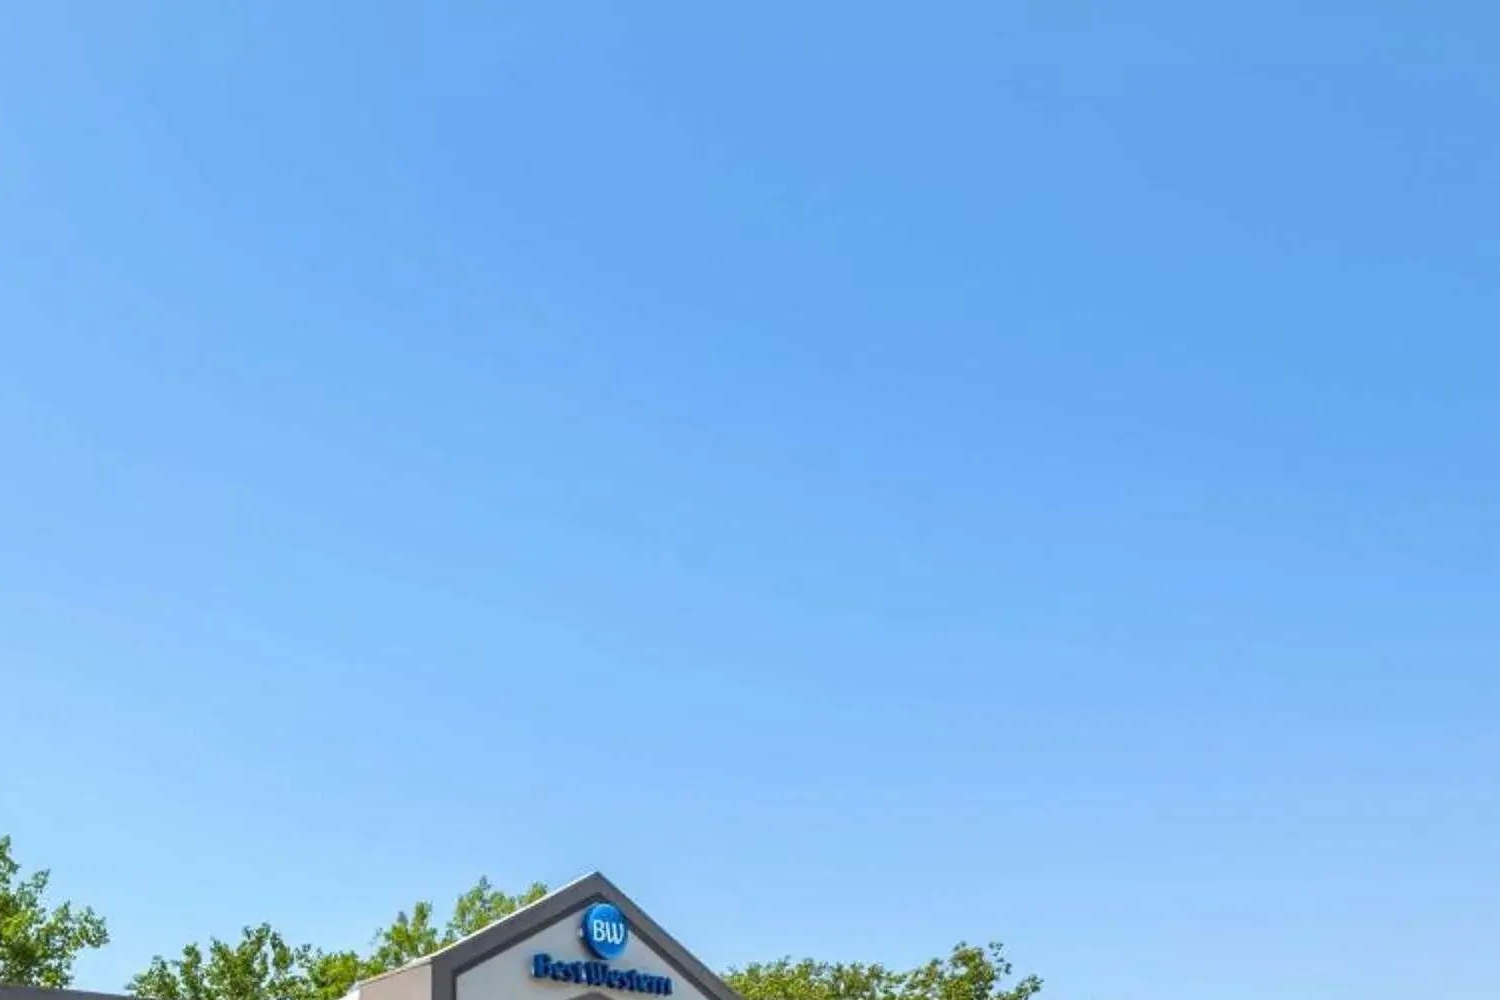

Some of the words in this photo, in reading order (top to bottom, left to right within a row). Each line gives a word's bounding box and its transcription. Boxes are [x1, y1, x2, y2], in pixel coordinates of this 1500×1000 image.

[593, 919, 624, 945] BW
[532, 953, 582, 984] Best
[583, 961, 672, 996] Western
